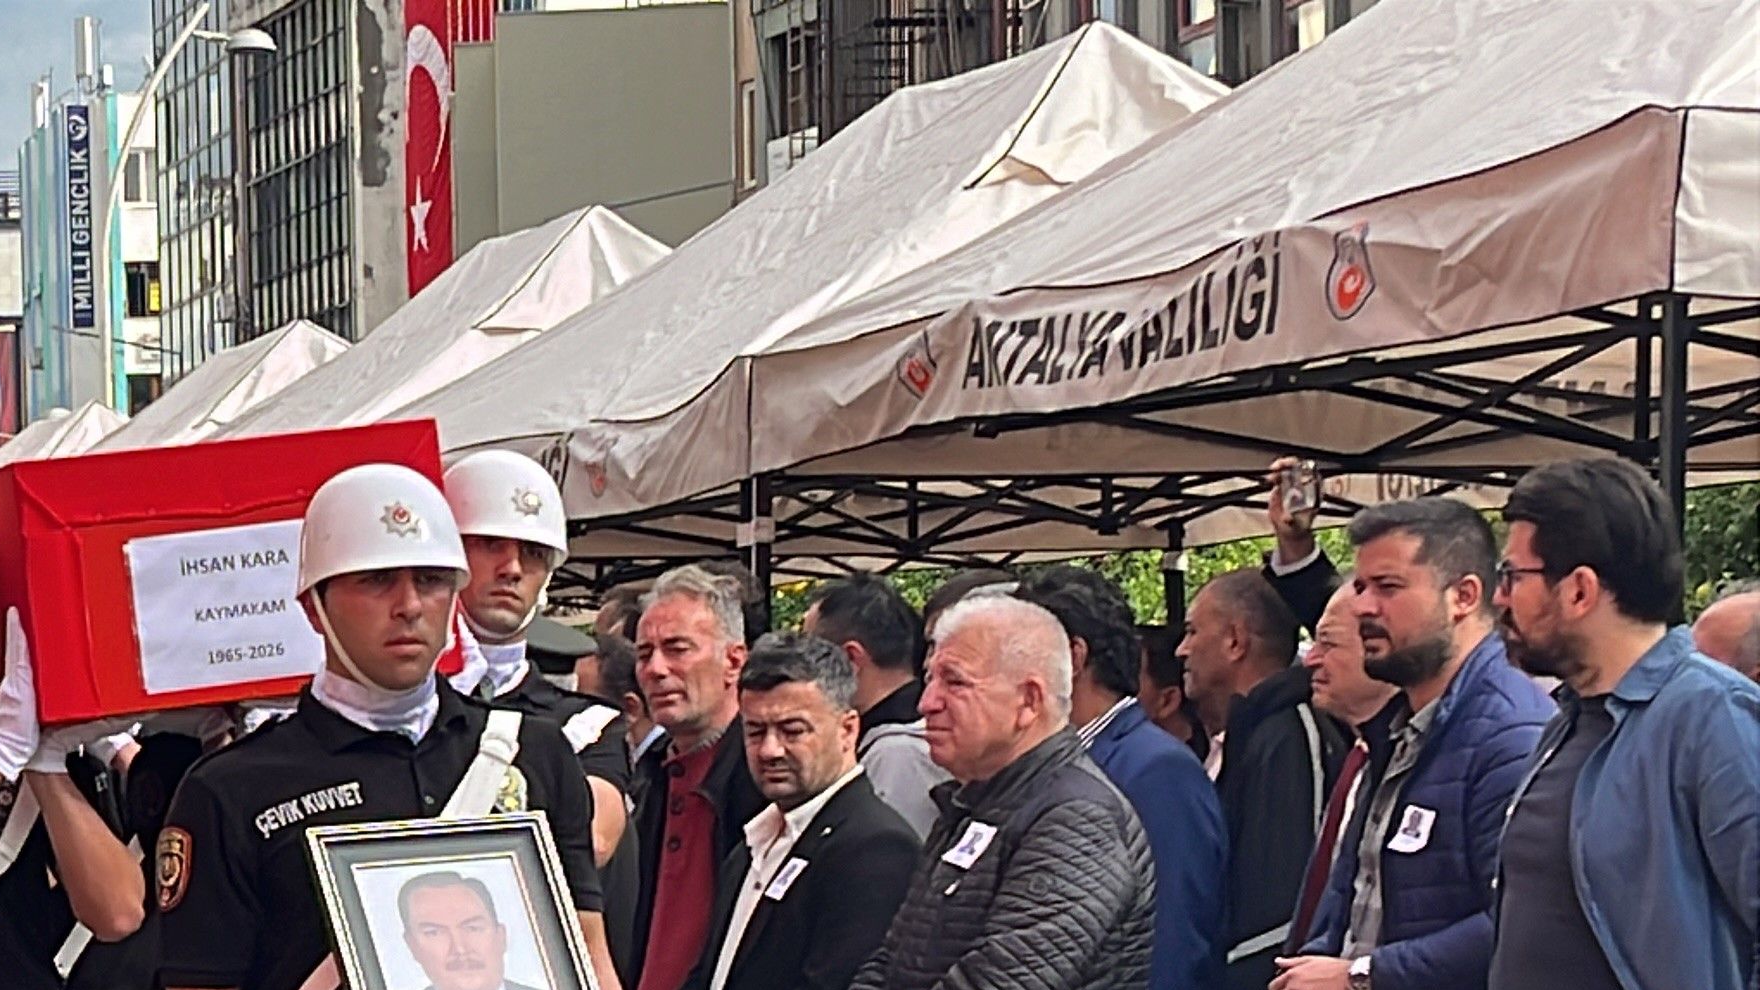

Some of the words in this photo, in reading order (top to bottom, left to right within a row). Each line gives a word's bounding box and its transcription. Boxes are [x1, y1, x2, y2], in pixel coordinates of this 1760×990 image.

[179, 554, 236, 577] İHSAN
[241, 549, 290, 569] KARA
[195, 599, 287, 622] KAYMAKAM
[207, 642, 286, 665] 1965-2026
[300, 781, 363, 815] KUVVET
